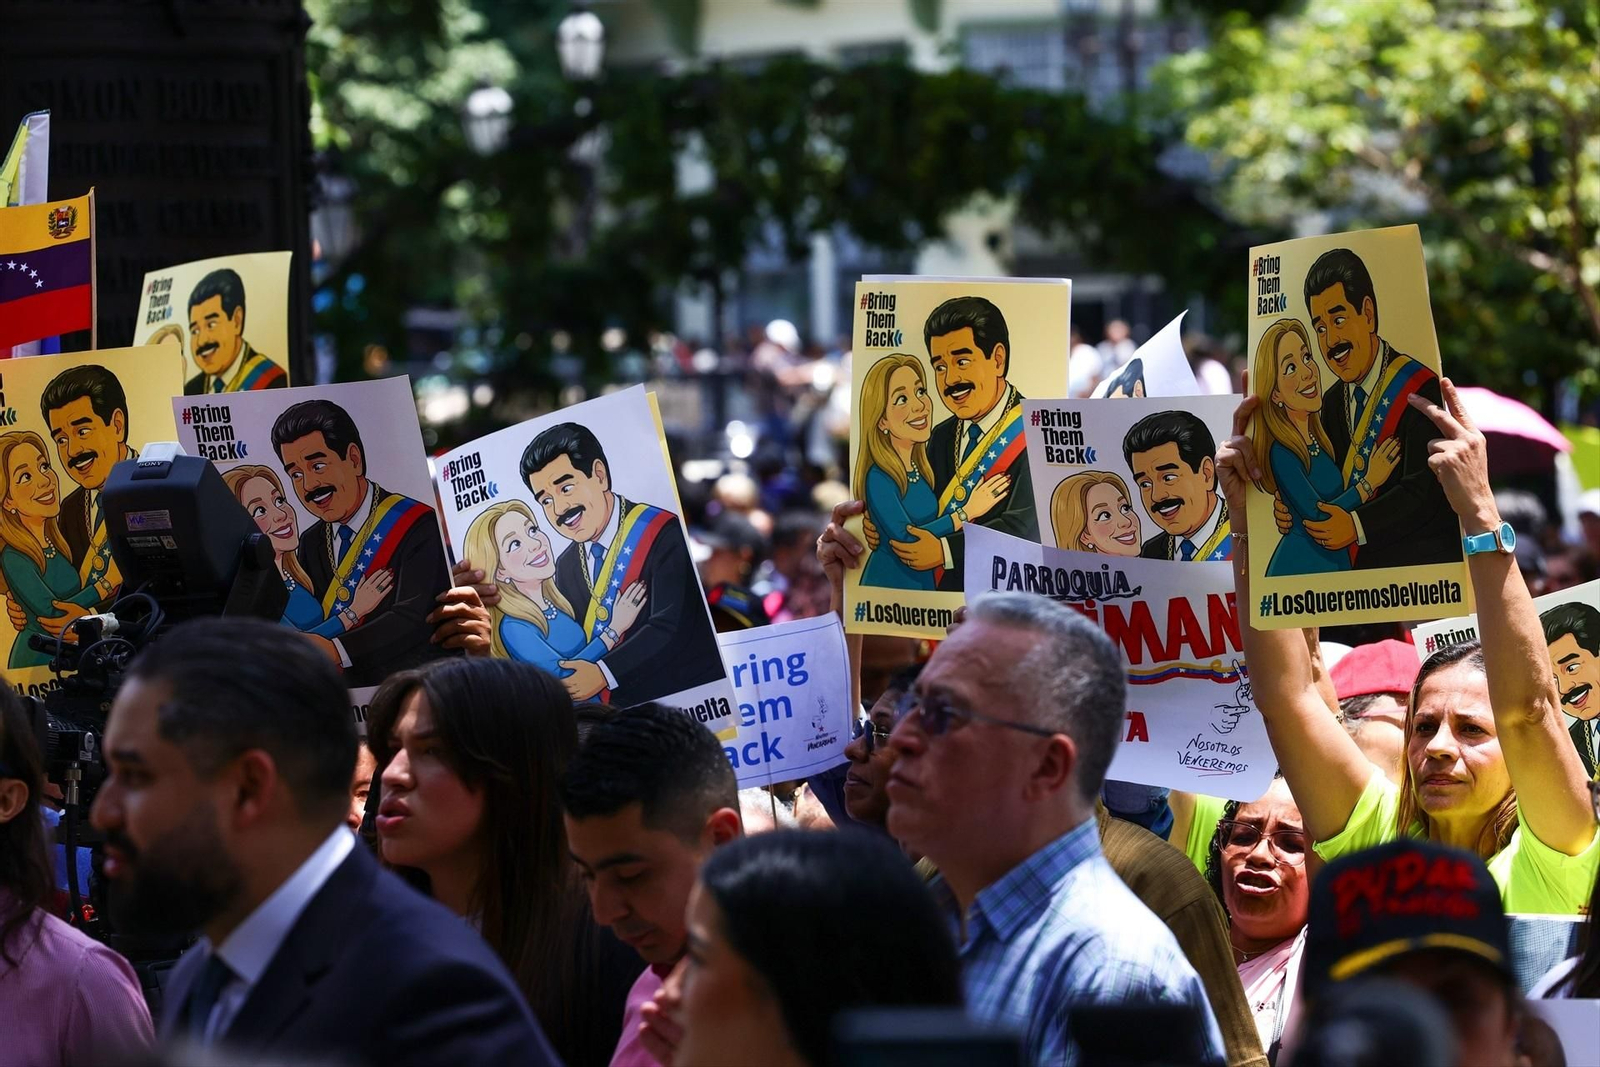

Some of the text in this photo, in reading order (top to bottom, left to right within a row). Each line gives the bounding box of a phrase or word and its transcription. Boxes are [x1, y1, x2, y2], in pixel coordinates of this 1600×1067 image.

[1253, 254, 1281, 276] #Bring
[1257, 276, 1280, 296] Them
[150, 294, 170, 308] Them
[860, 291, 897, 311] #Bring
[1257, 294, 1280, 316] Back
[146, 308, 167, 325] Back
[866, 311, 896, 329] Them
[865, 329, 895, 347] Back
[182, 404, 232, 425] #Bring
[1031, 408, 1082, 429] #Bring
[193, 425, 235, 443] Them
[1041, 428, 1085, 446] Them
[198, 442, 239, 461] Back
[1045, 446, 1087, 465] Back
[443, 451, 482, 482] #Bring
[451, 469, 486, 495] Them
[455, 485, 490, 512] Back
[1260, 579, 1462, 617] #LosQueremosDeVuelta
[854, 600, 952, 627] #LosQuerem
[733, 652, 809, 687] ring
[679, 697, 732, 723] uelta
[739, 696, 793, 726] em
[723, 732, 785, 768] ack
